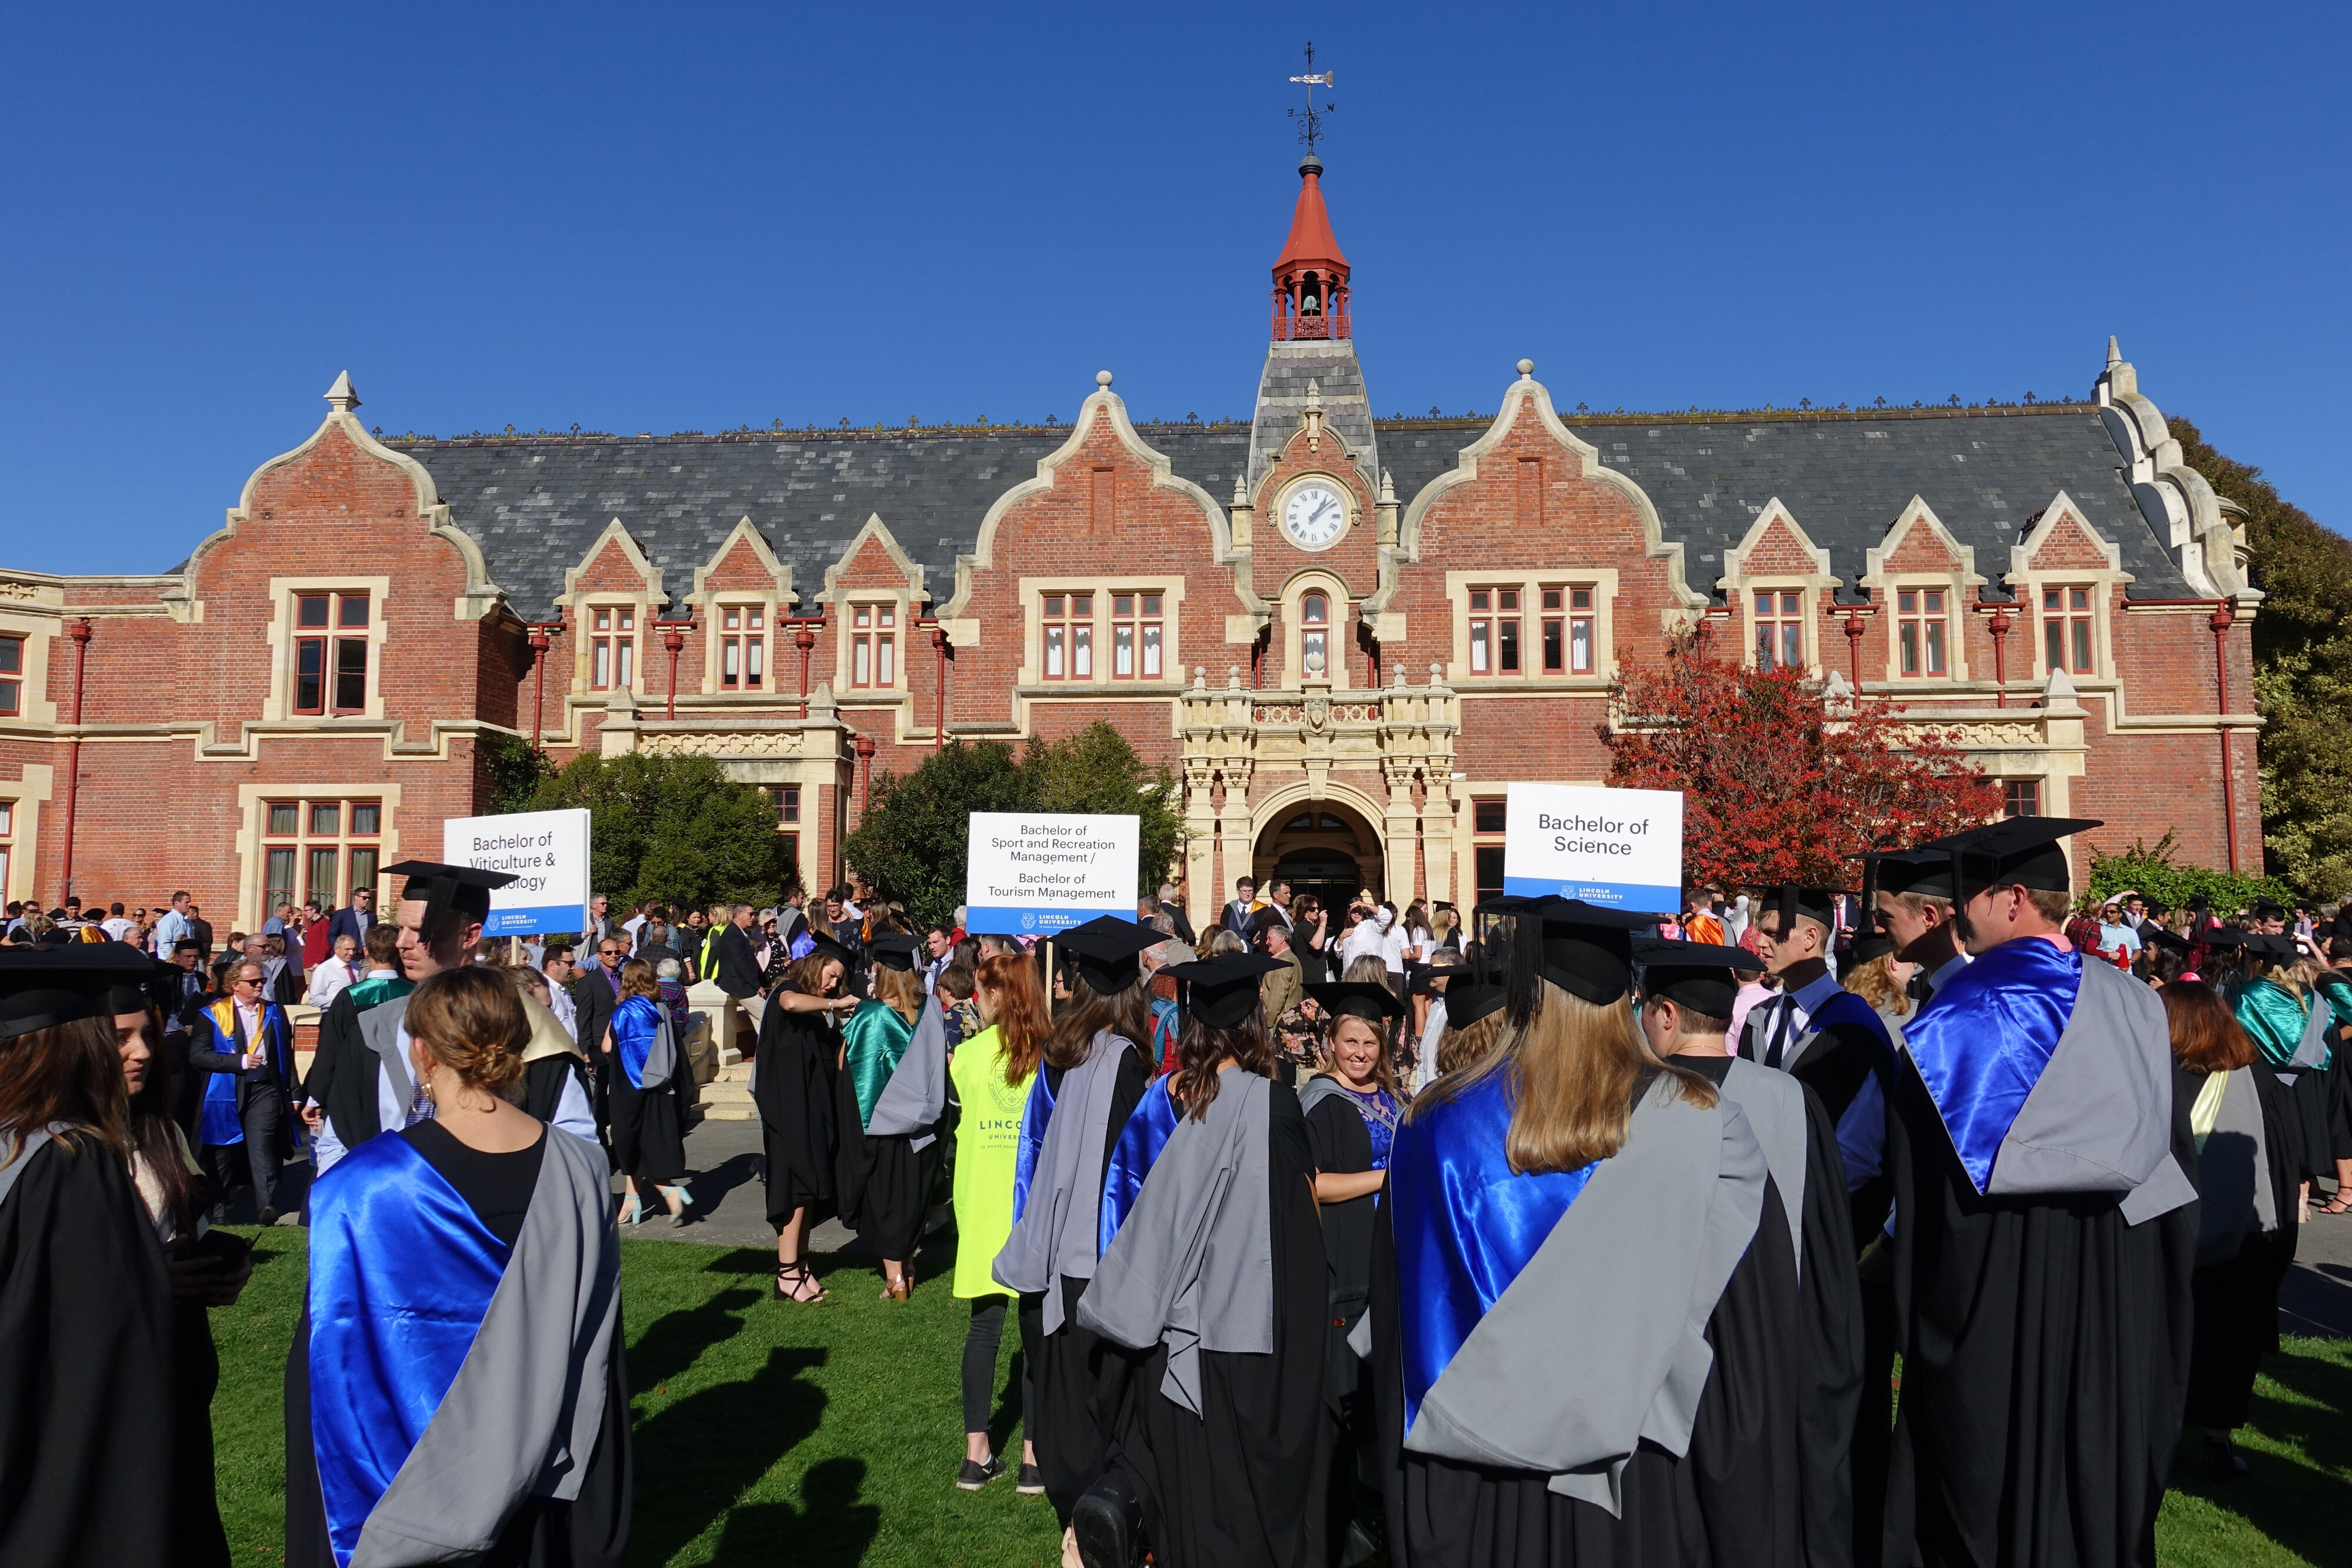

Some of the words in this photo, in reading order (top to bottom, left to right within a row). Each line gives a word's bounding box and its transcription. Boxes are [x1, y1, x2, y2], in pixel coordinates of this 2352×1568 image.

[1020, 825, 1072, 835] Bachelor
[1075, 826, 1087, 835] of
[1539, 814, 1624, 833] Bachelor
[1630, 819, 1649, 835] of
[473, 833, 534, 851] Bachelor
[538, 831, 553, 846] of
[992, 838, 1023, 849] Sport
[1027, 839, 1048, 848] and
[1052, 839, 1115, 849] Recreation
[1554, 836, 1632, 855] Science
[469, 855, 541, 870] Viticulture
[546, 853, 555, 866] &
[1010, 852, 1087, 863] Management
[1090, 852, 1096, 864] /
[499, 876, 546, 891] ology
[1019, 873, 1070, 883] Bachelor
[1074, 874, 1086, 883] of
[989, 886, 1035, 896] Tourism
[1038, 888, 1116, 899] Management
[980, 1120, 1022, 1130] LINCO
